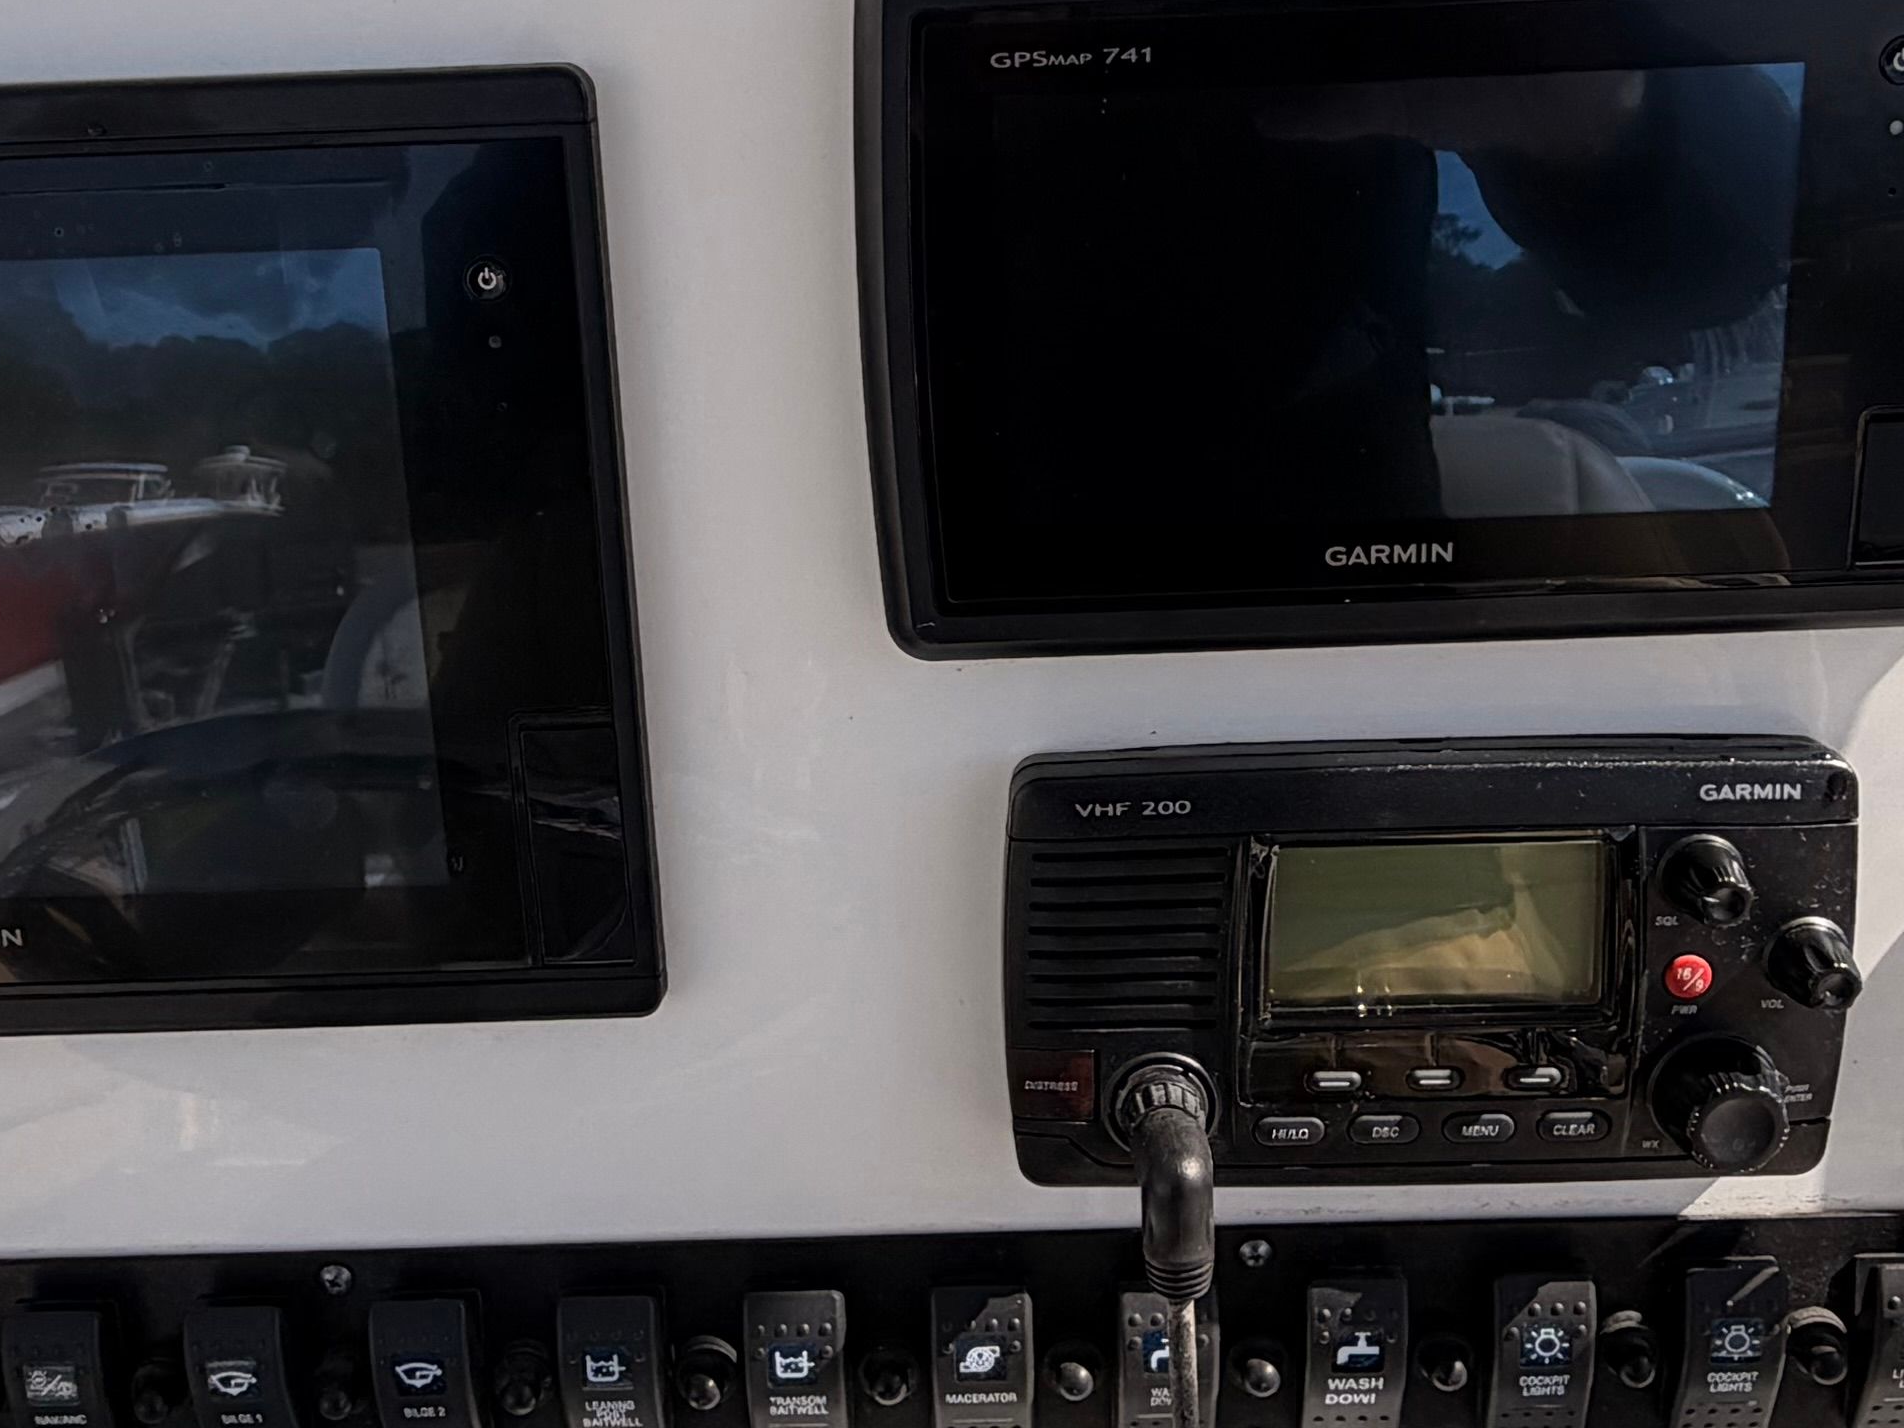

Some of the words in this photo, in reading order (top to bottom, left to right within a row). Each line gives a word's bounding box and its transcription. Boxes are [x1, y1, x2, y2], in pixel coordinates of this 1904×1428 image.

[1103, 47, 1152, 65] 741
[1325, 542, 1453, 566] GARMIN
[1700, 783, 1801, 801] GARMIN
[1075, 802, 1132, 817] VHF
[1142, 800, 1192, 815] 200
[1761, 999, 1784, 1009] VOL
[1372, 1126, 1400, 1139] DSC
[1461, 1125, 1499, 1137] MENU
[1552, 1123, 1595, 1136] CLEAR
[1328, 1377, 1385, 1390] WASH
[1519, 1375, 1570, 1386] COCKPIT
[1707, 1372, 1759, 1383] COCKPIT
[1522, 1385, 1565, 1397] LIGHTS
[1709, 1382, 1752, 1393] LIGHTS
[769, 1396, 827, 1406] TRANSOM
[945, 1392, 1017, 1404] MACERATOR
[585, 1400, 635, 1411] LEANING
[770, 1405, 828, 1415] BAITWELL
[404, 1407, 435, 1418] BILGE
[437, 1406, 446, 1417] 2
[583, 1417, 643, 1428] BAITWELL
